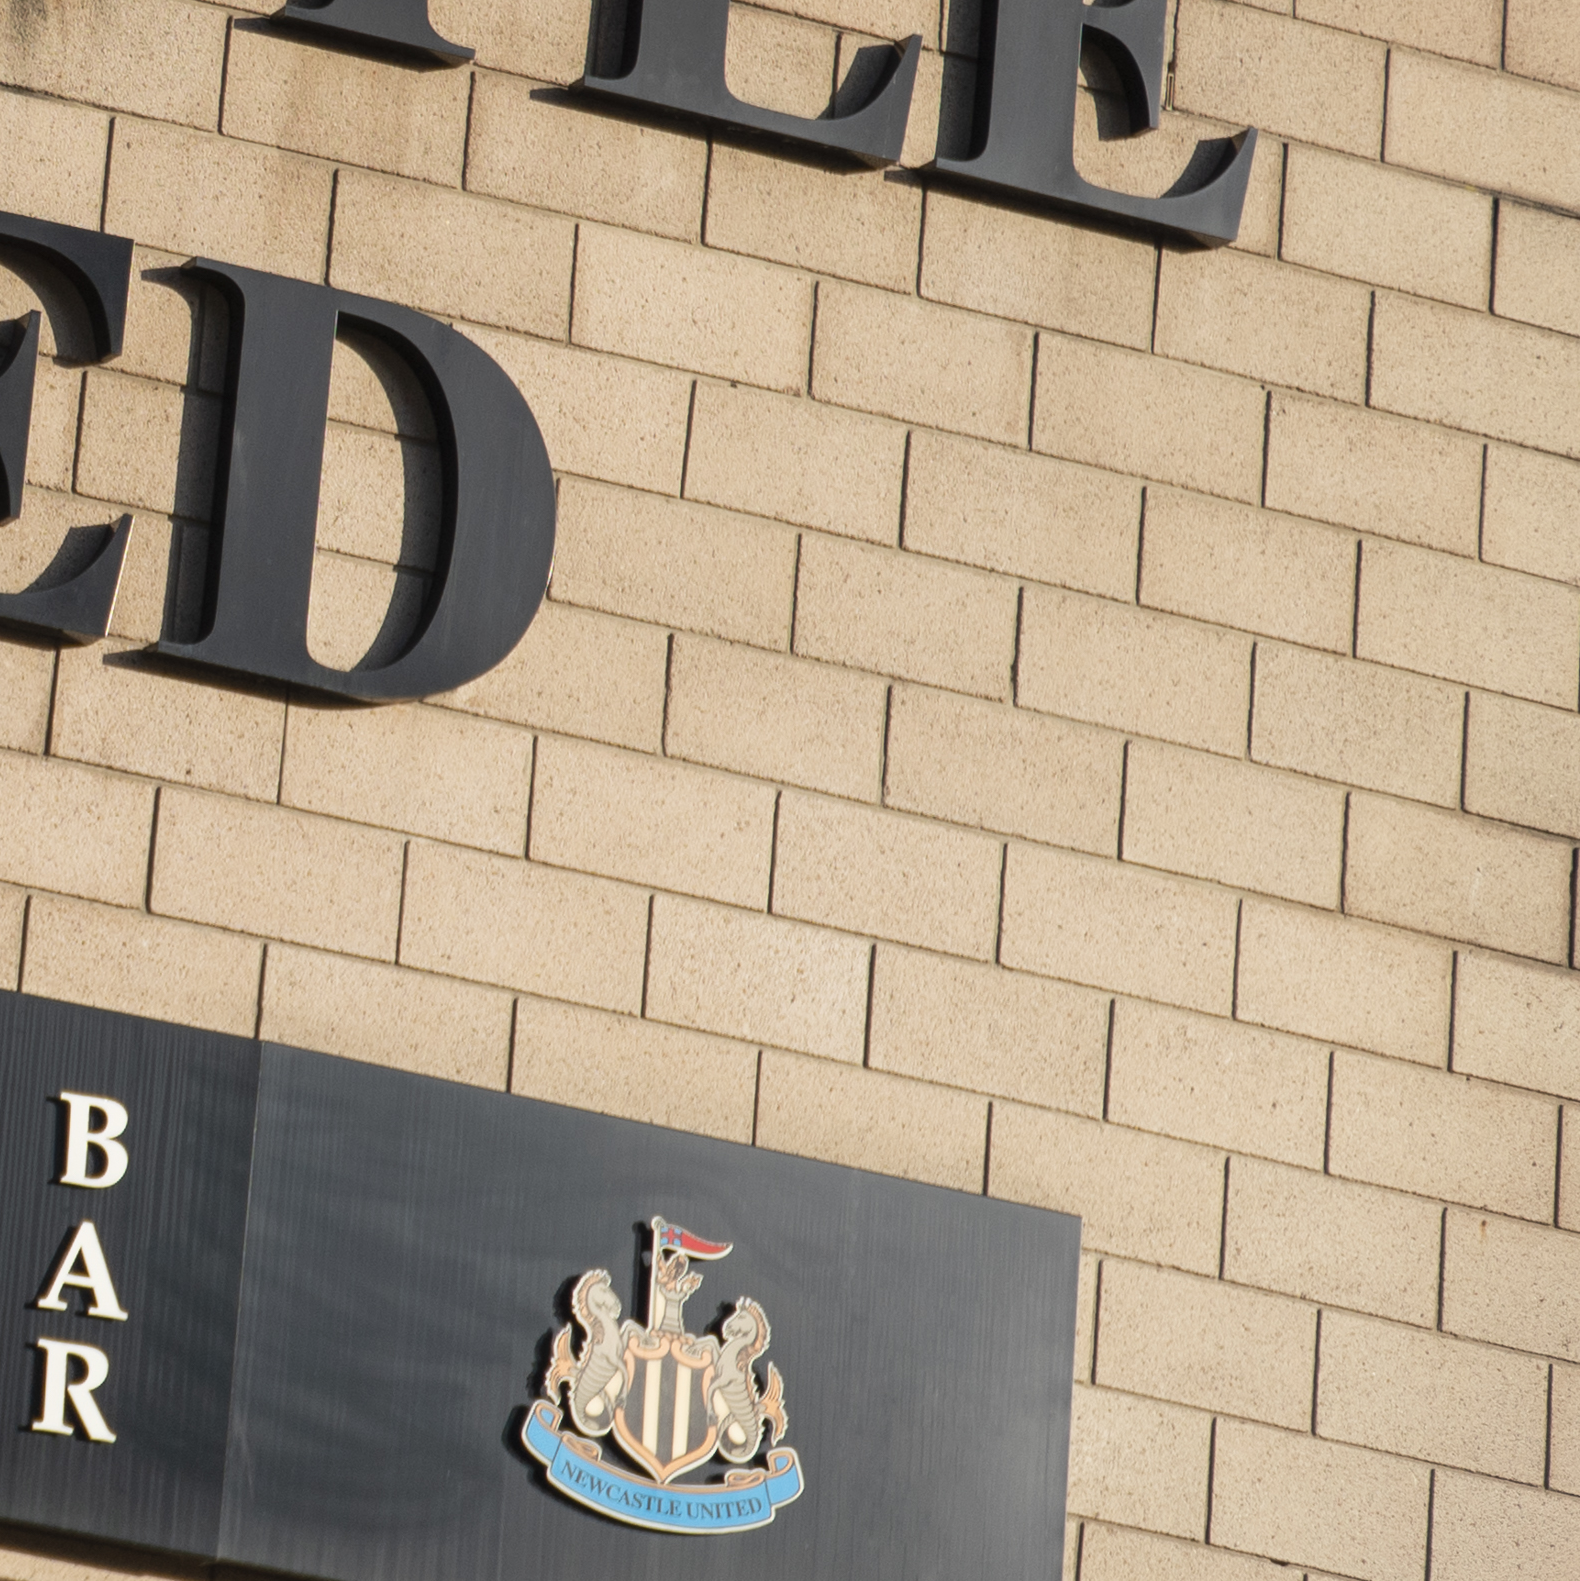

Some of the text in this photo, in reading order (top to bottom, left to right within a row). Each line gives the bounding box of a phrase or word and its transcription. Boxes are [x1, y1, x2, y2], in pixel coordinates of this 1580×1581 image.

[31, 1090, 130, 1444] BAR
[561, 1459, 763, 1519] NEWCASTLE UNITED
